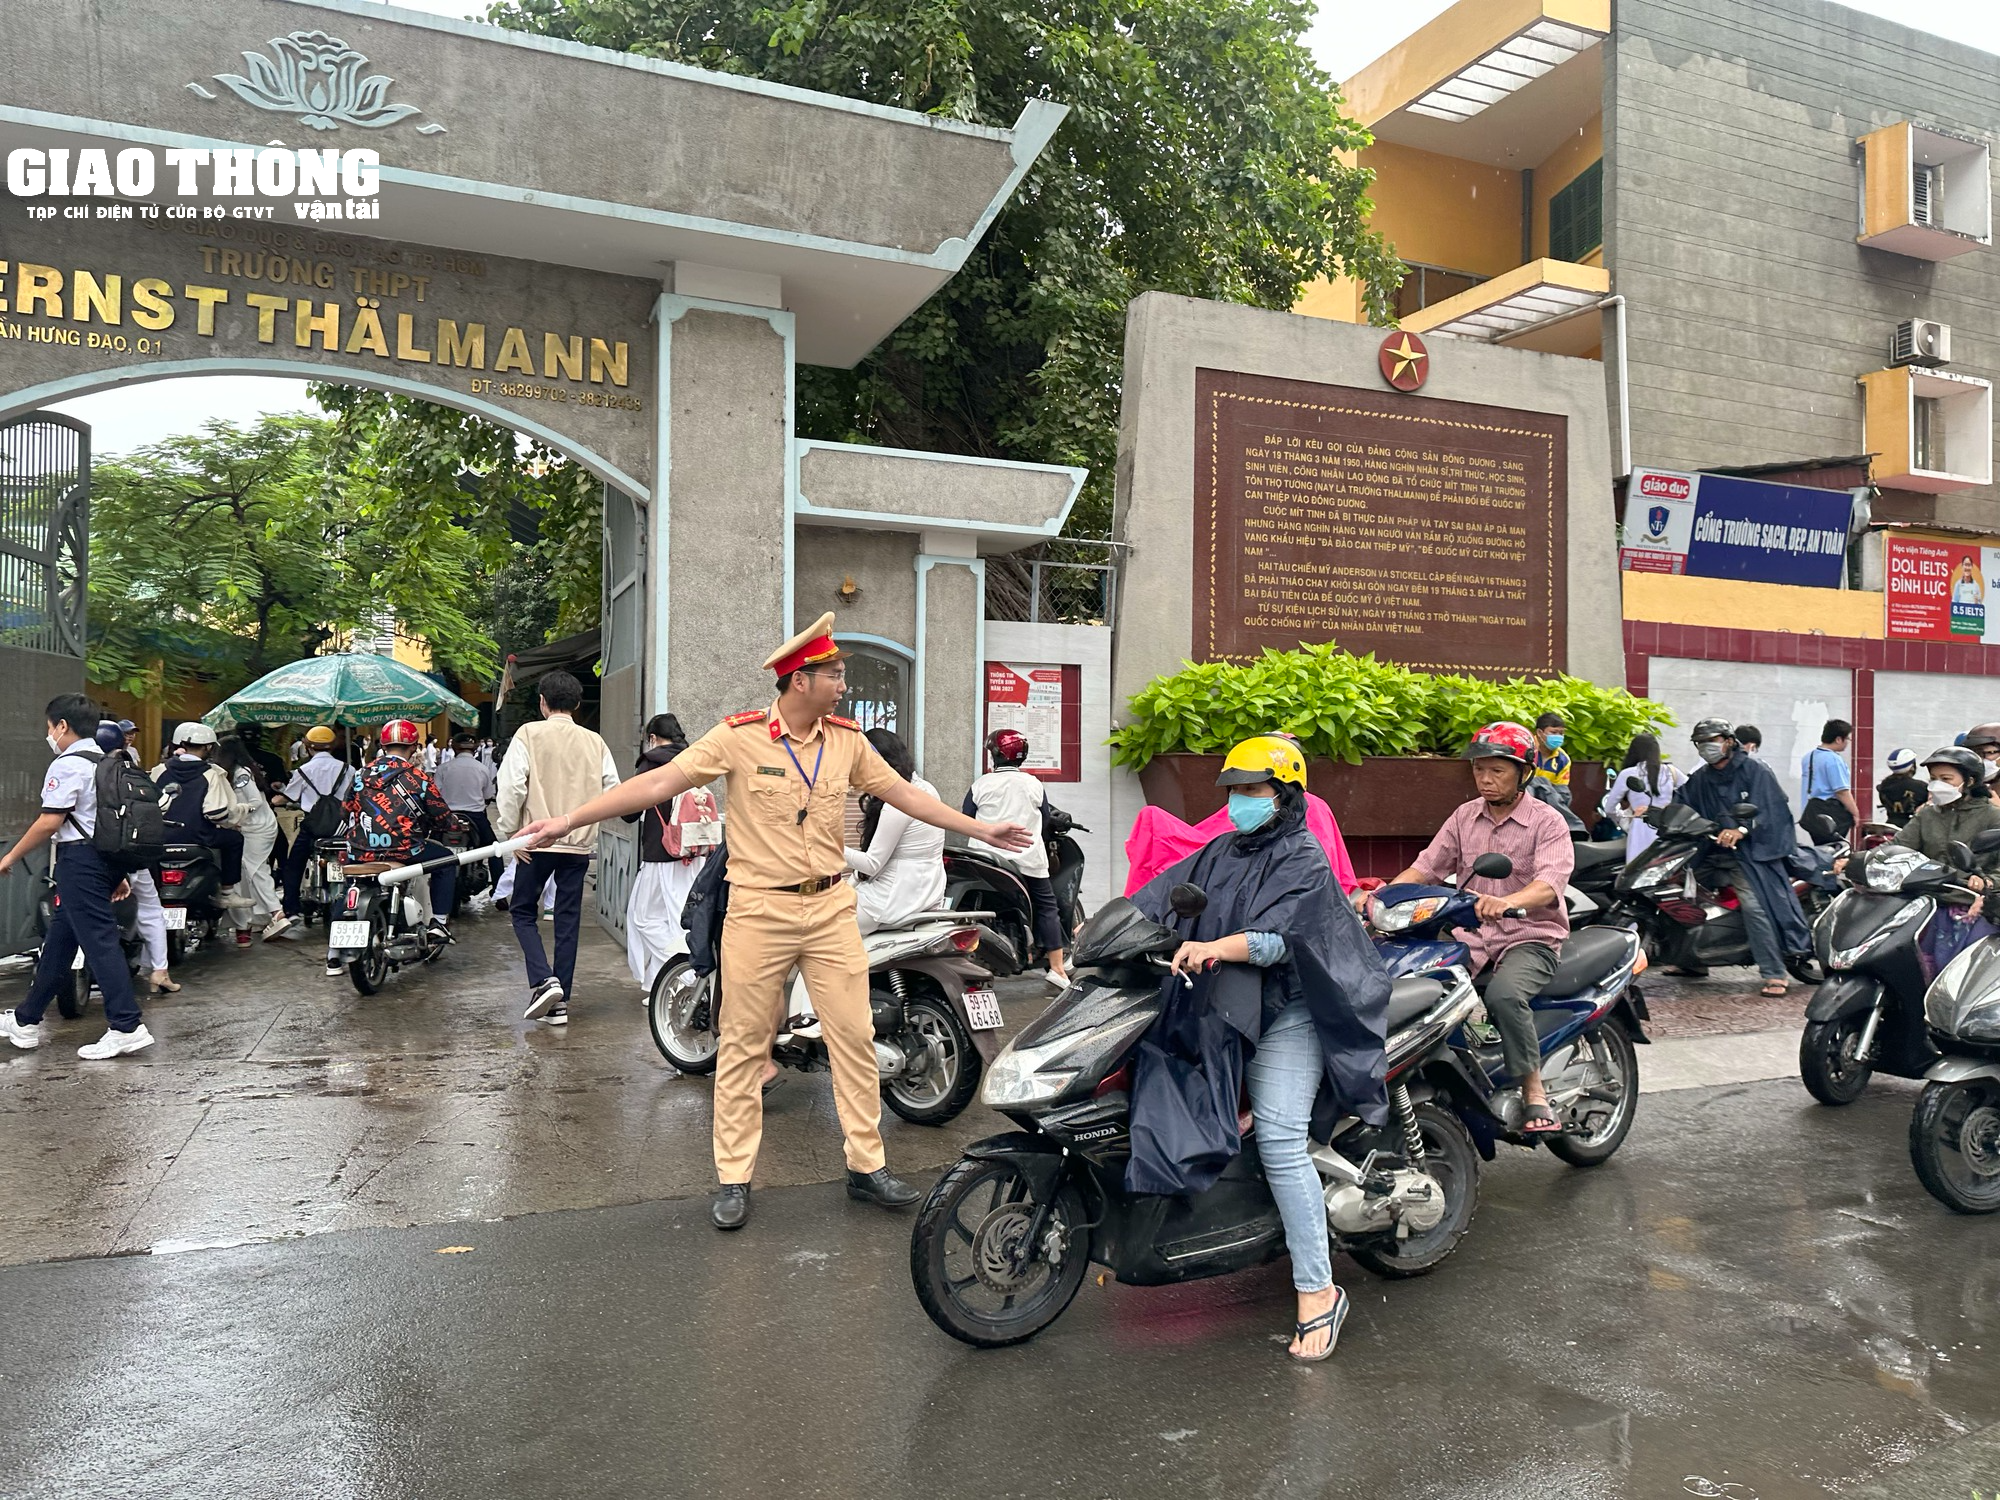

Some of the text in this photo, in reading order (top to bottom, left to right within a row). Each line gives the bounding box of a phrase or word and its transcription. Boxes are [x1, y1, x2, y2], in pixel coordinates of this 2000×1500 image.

[199, 246, 430, 302] TRƯỜNG THPT
[0, 260, 628, 386] RNST THÄLMANN
[28, 325, 81, 346] HƯNG
[87, 332, 132, 355] ĐẠO,
[500, 382, 567, 402] 38299702
[1642, 477, 1689, 496] giáo dục
[1694, 510, 1723, 543] CỔNG
[1722, 517, 1761, 547] TRƯỜNG
[1761, 523, 1788, 554] SẠCH,
[1806, 529, 1821, 554] AN
[1820, 527, 1845, 556] TOÀN
[1892, 544, 1948, 557] Học viện Tiếng Anh
[1891, 557, 1948, 577] DOL IELTS
[1891, 574, 1947, 599] ĐÌNH LỰC
[1952, 605, 1965, 615] 8.5
[1965, 606, 1984, 617] IELTS
[336, 923, 363, 935] 59-FA
[332, 935, 367, 947] 027.29
[968, 994, 993, 1010] 59-F1
[971, 1010, 1001, 1027] 464.68
[1073, 1127, 1118, 1142] HONDA
